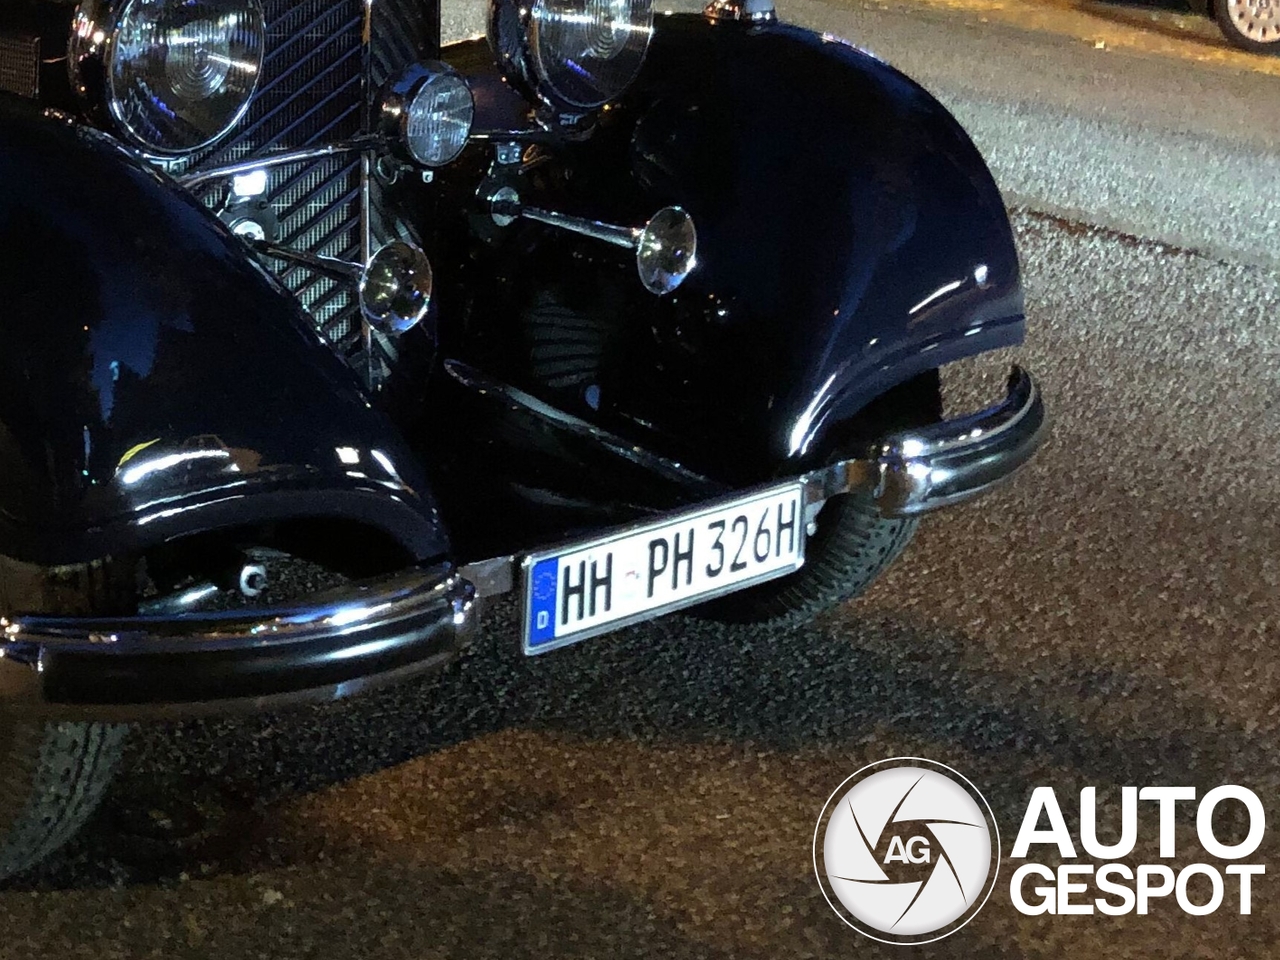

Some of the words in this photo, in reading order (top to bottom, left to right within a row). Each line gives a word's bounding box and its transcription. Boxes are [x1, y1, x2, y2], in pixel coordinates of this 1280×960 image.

[561, 553, 613, 625] HH
[647, 528, 695, 598] PH
[705, 500, 797, 578] 326H
[537, 612, 549, 630] D
